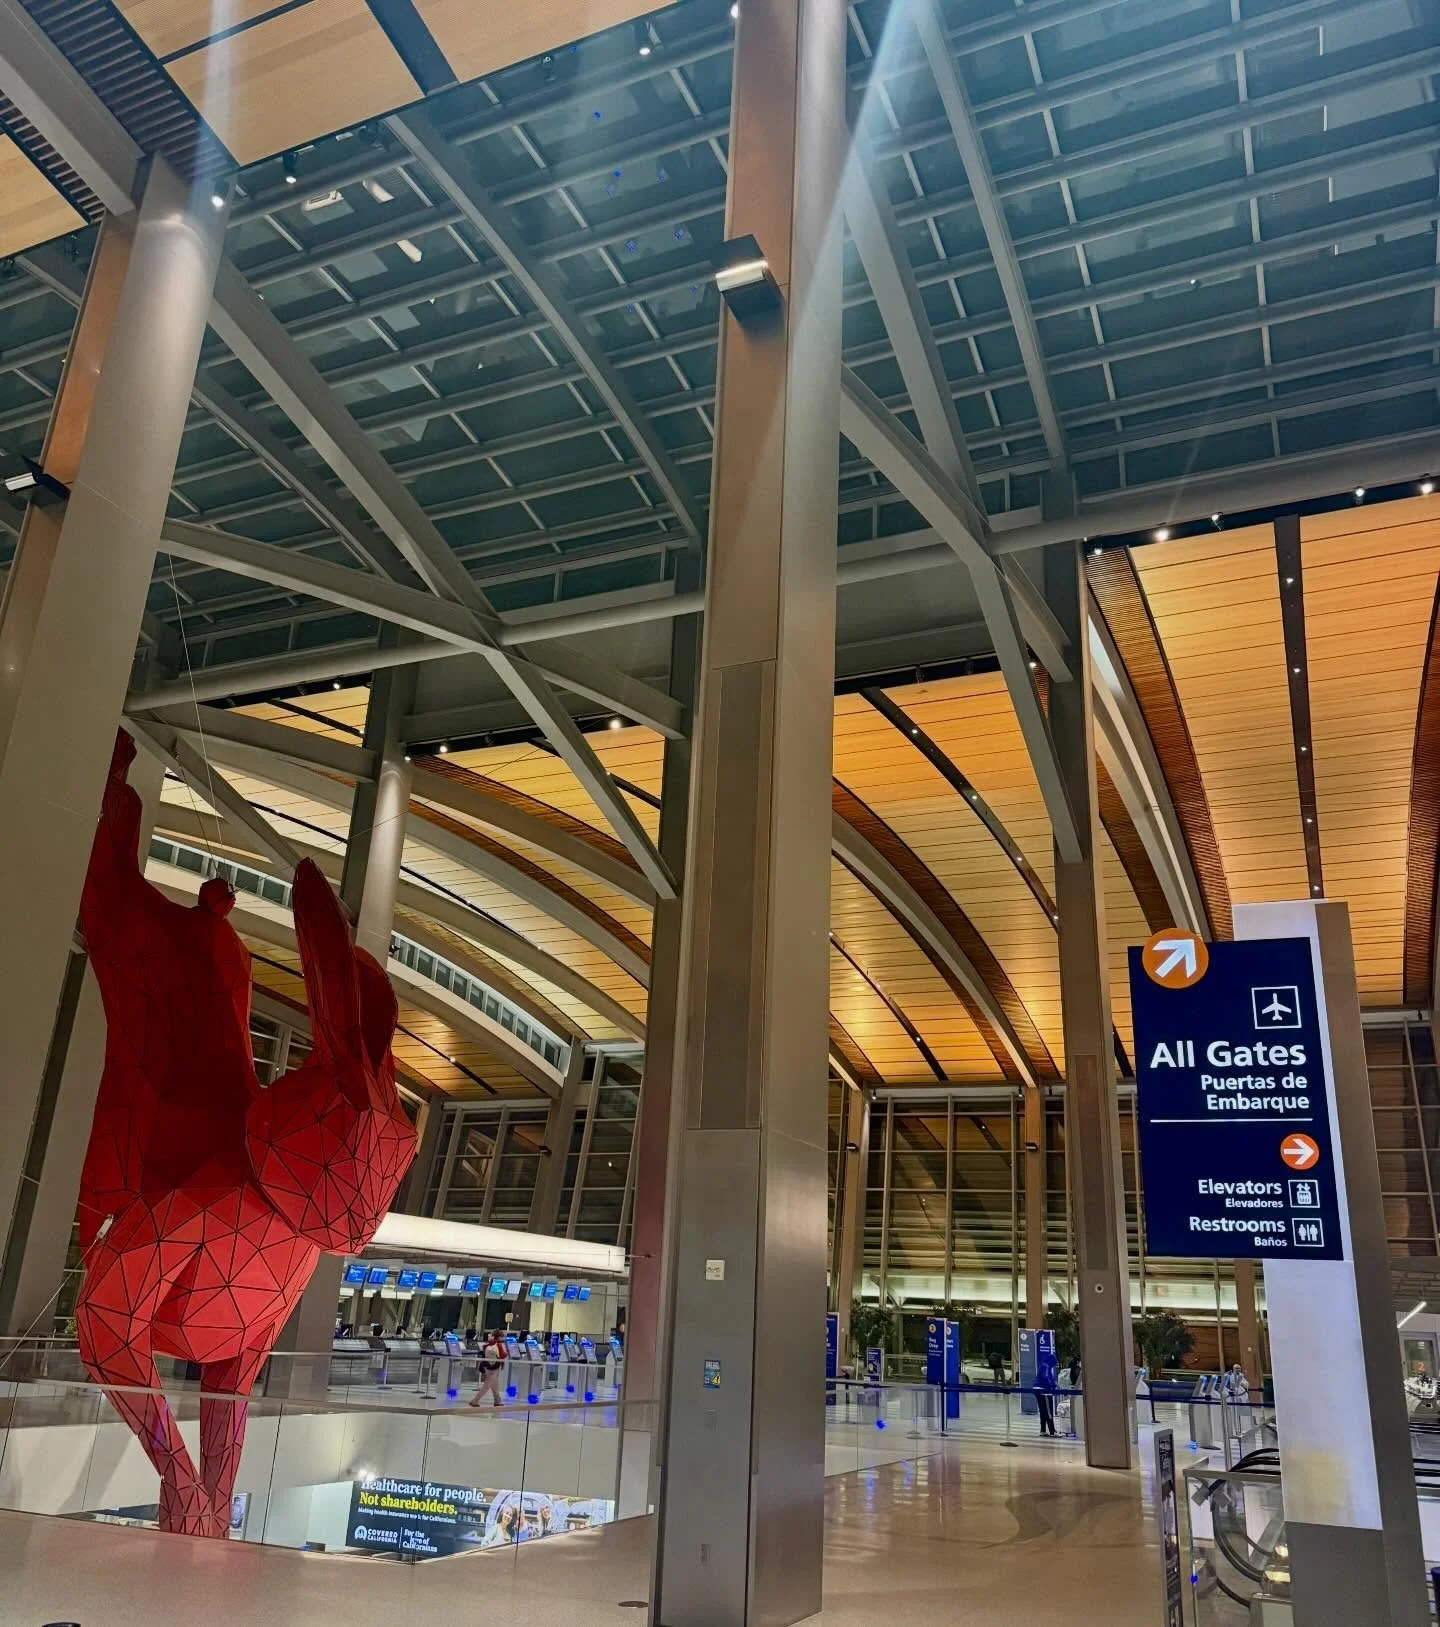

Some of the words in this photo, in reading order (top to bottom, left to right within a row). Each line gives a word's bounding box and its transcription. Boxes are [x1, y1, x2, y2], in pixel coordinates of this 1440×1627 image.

[1150, 1040, 1195, 1068] All
[1206, 1040, 1307, 1067] Gates
[1201, 1074, 1276, 1090] Puertas
[1282, 1072, 1307, 1089] de
[1206, 1092, 1310, 1113] Embarque
[1198, 1178, 1283, 1195] Elevators
[1225, 1198, 1284, 1208] Elevadores
[1189, 1216, 1286, 1233] Restrooms
[1254, 1236, 1287, 1247] Baños
[424, 1483, 442, 1497] for
[444, 1488, 487, 1504] people.
[360, 1491, 379, 1505] Not
[380, 1494, 458, 1515] shareholders.
[367, 1528, 398, 1538] COVERED
[367, 1536, 397, 1544] CALIFORNIA
